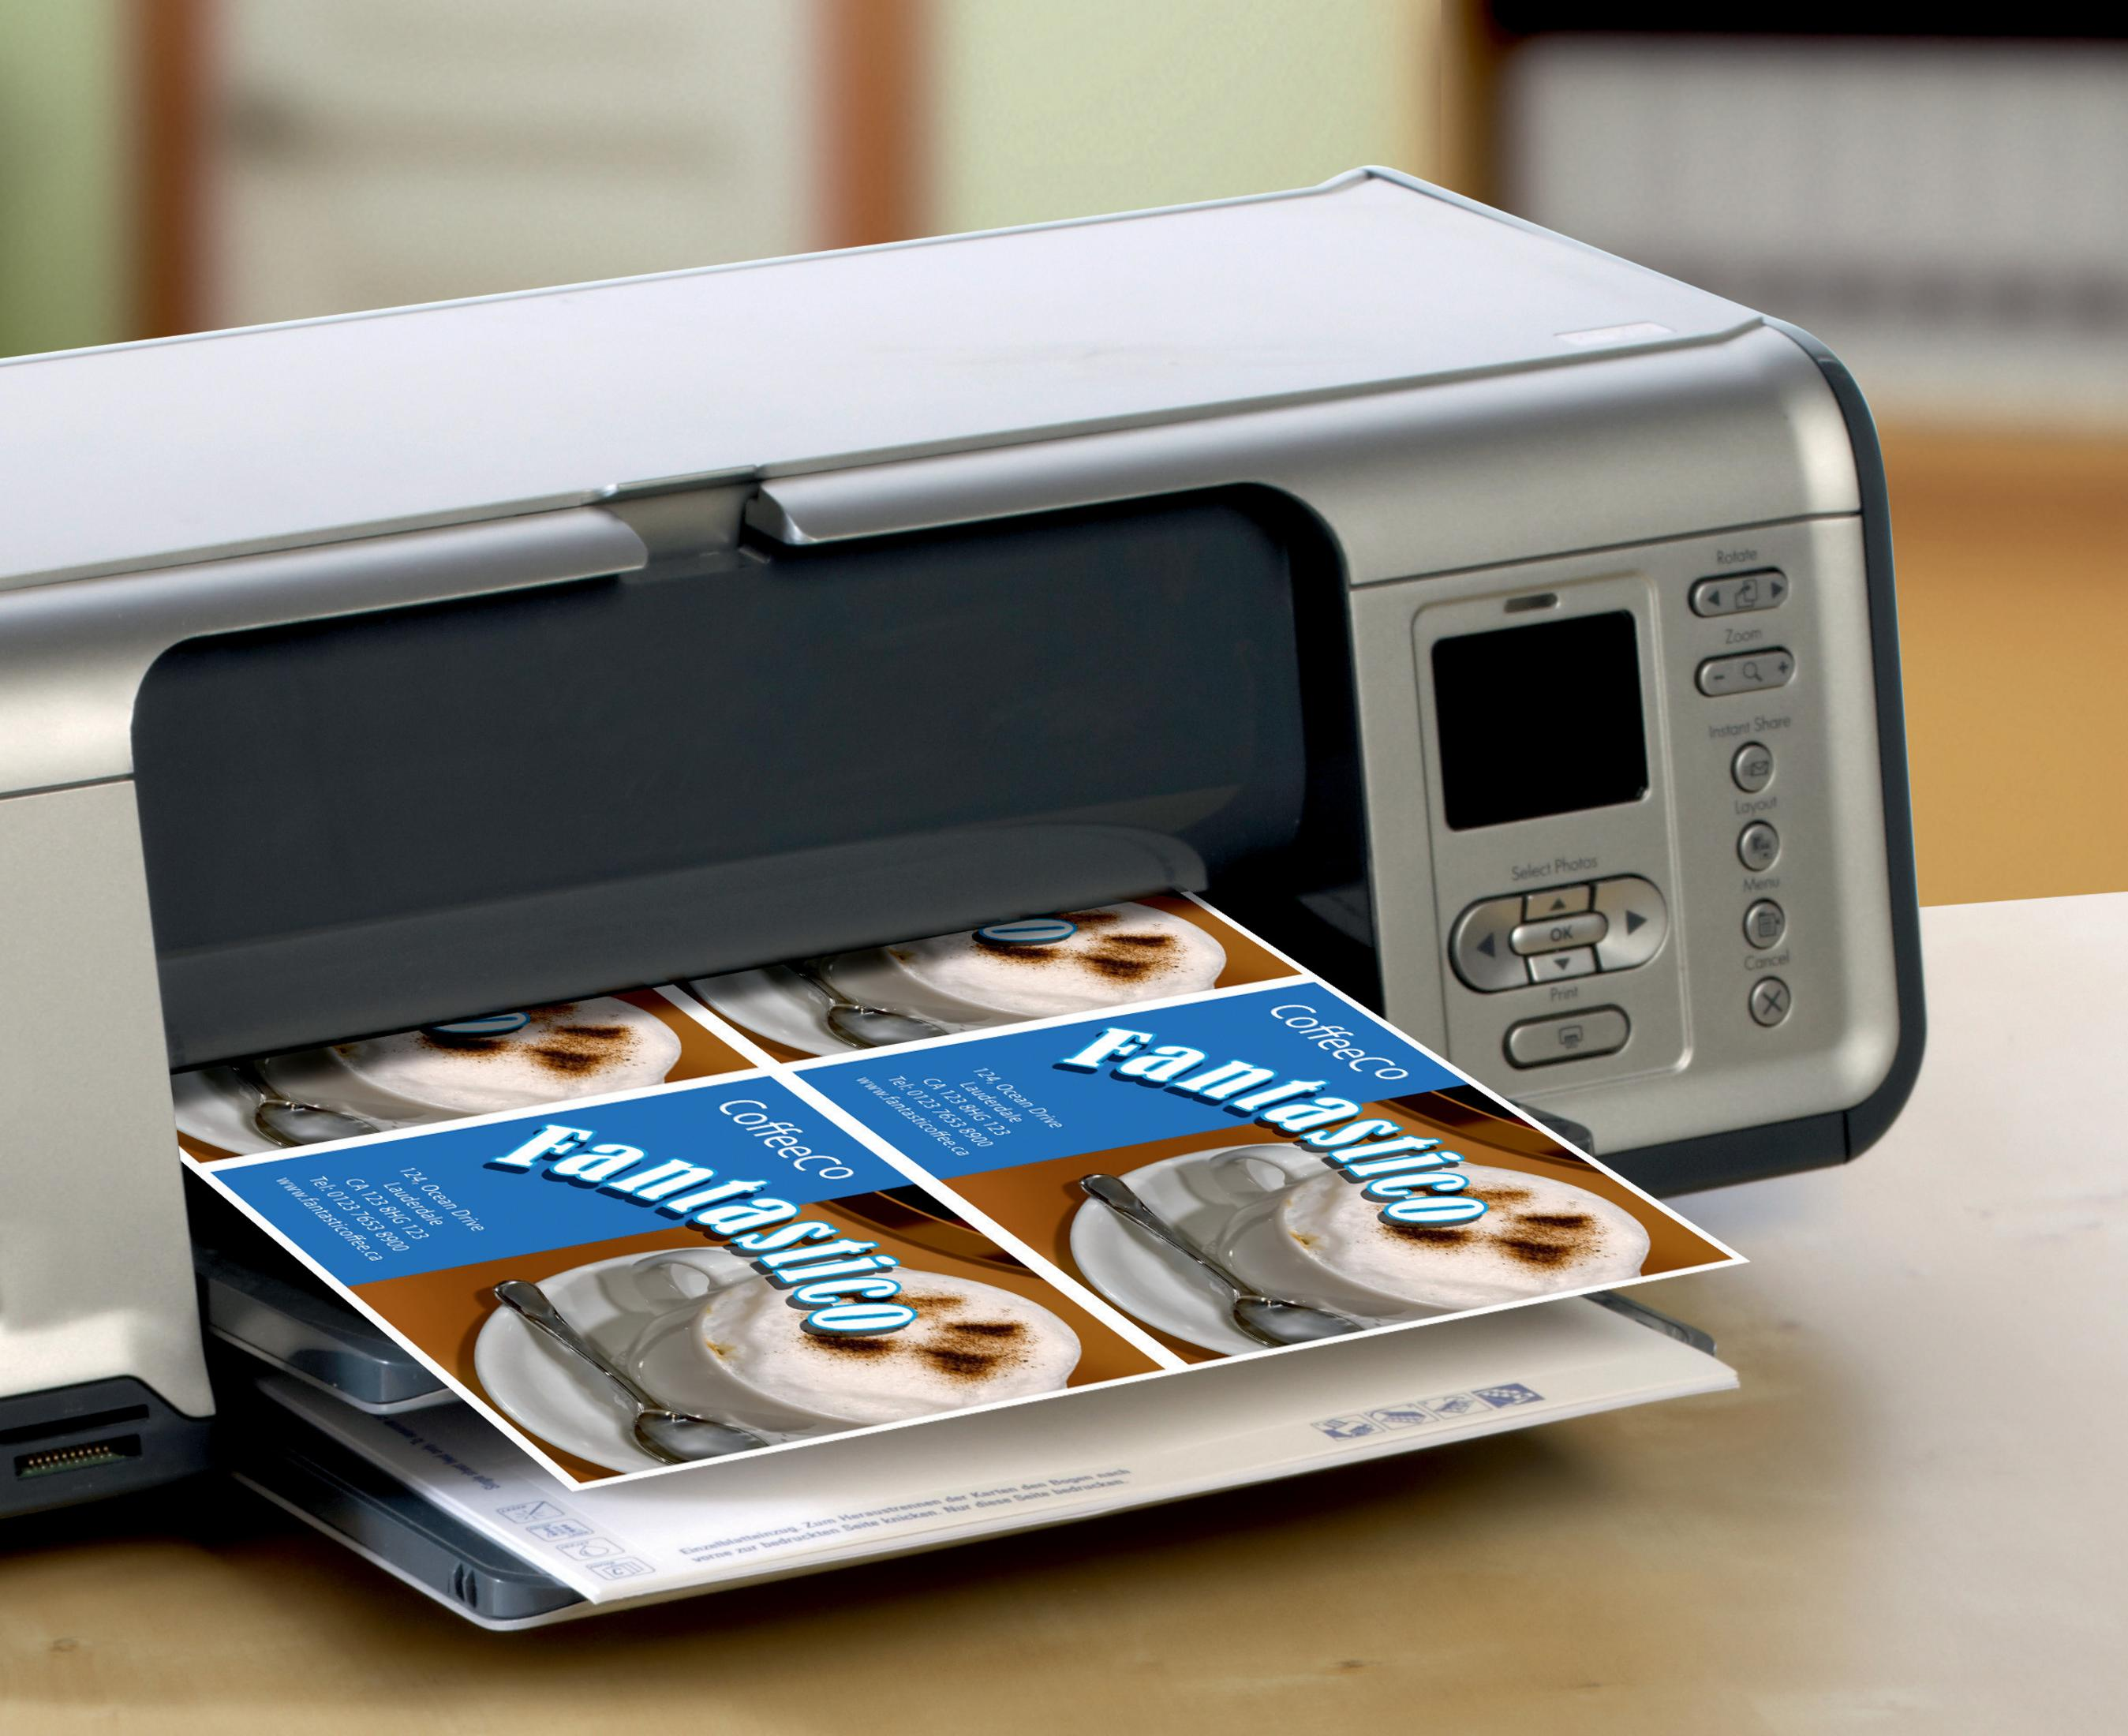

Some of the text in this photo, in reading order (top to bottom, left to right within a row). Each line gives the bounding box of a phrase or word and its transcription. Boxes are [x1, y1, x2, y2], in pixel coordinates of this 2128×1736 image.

[1717, 549, 1758, 564] Rotate
[1726, 629, 1763, 645] Zoom
[1709, 715, 1791, 739] Instant Share
[1735, 797, 1778, 816] Layout
[1512, 857, 1599, 881] Select Photos
[1743, 877, 1780, 893] Menu
[1550, 925, 1573, 942] OK
[1744, 950, 1790, 971] Cancel
[1550, 986, 1578, 1002] Print
[856, 1076, 971, 1158] www.fantasticoffee.ca
[907, 1088, 941, 1109] 0123
[932, 1108, 967, 1129] 7653
[959, 1127, 994, 1148] 8900
[922, 1077, 1012, 1137] CA 123 8HG 123
[959, 1080, 1023, 1124] Lauderdale
[996, 1083, 1034, 1109] Ocean
[1028, 1106, 1063, 1129] Drive
[1061, 1026, 1490, 1228] Fantastico
[275, 1176, 384, 1263] www.fantasticoffee.ca
[326, 1189, 361, 1212] 0123
[350, 1210, 385, 1233] 7653
[375, 1229, 410, 1252] 8900
[345, 1177, 431, 1240] CA 123 8HG 123
[383, 1180, 444, 1226] Lauderdale
[421, 1184, 458, 1210] Ocean
[451, 1209, 485, 1233] Drive
[492, 1122, 918, 1334] Fantastico
